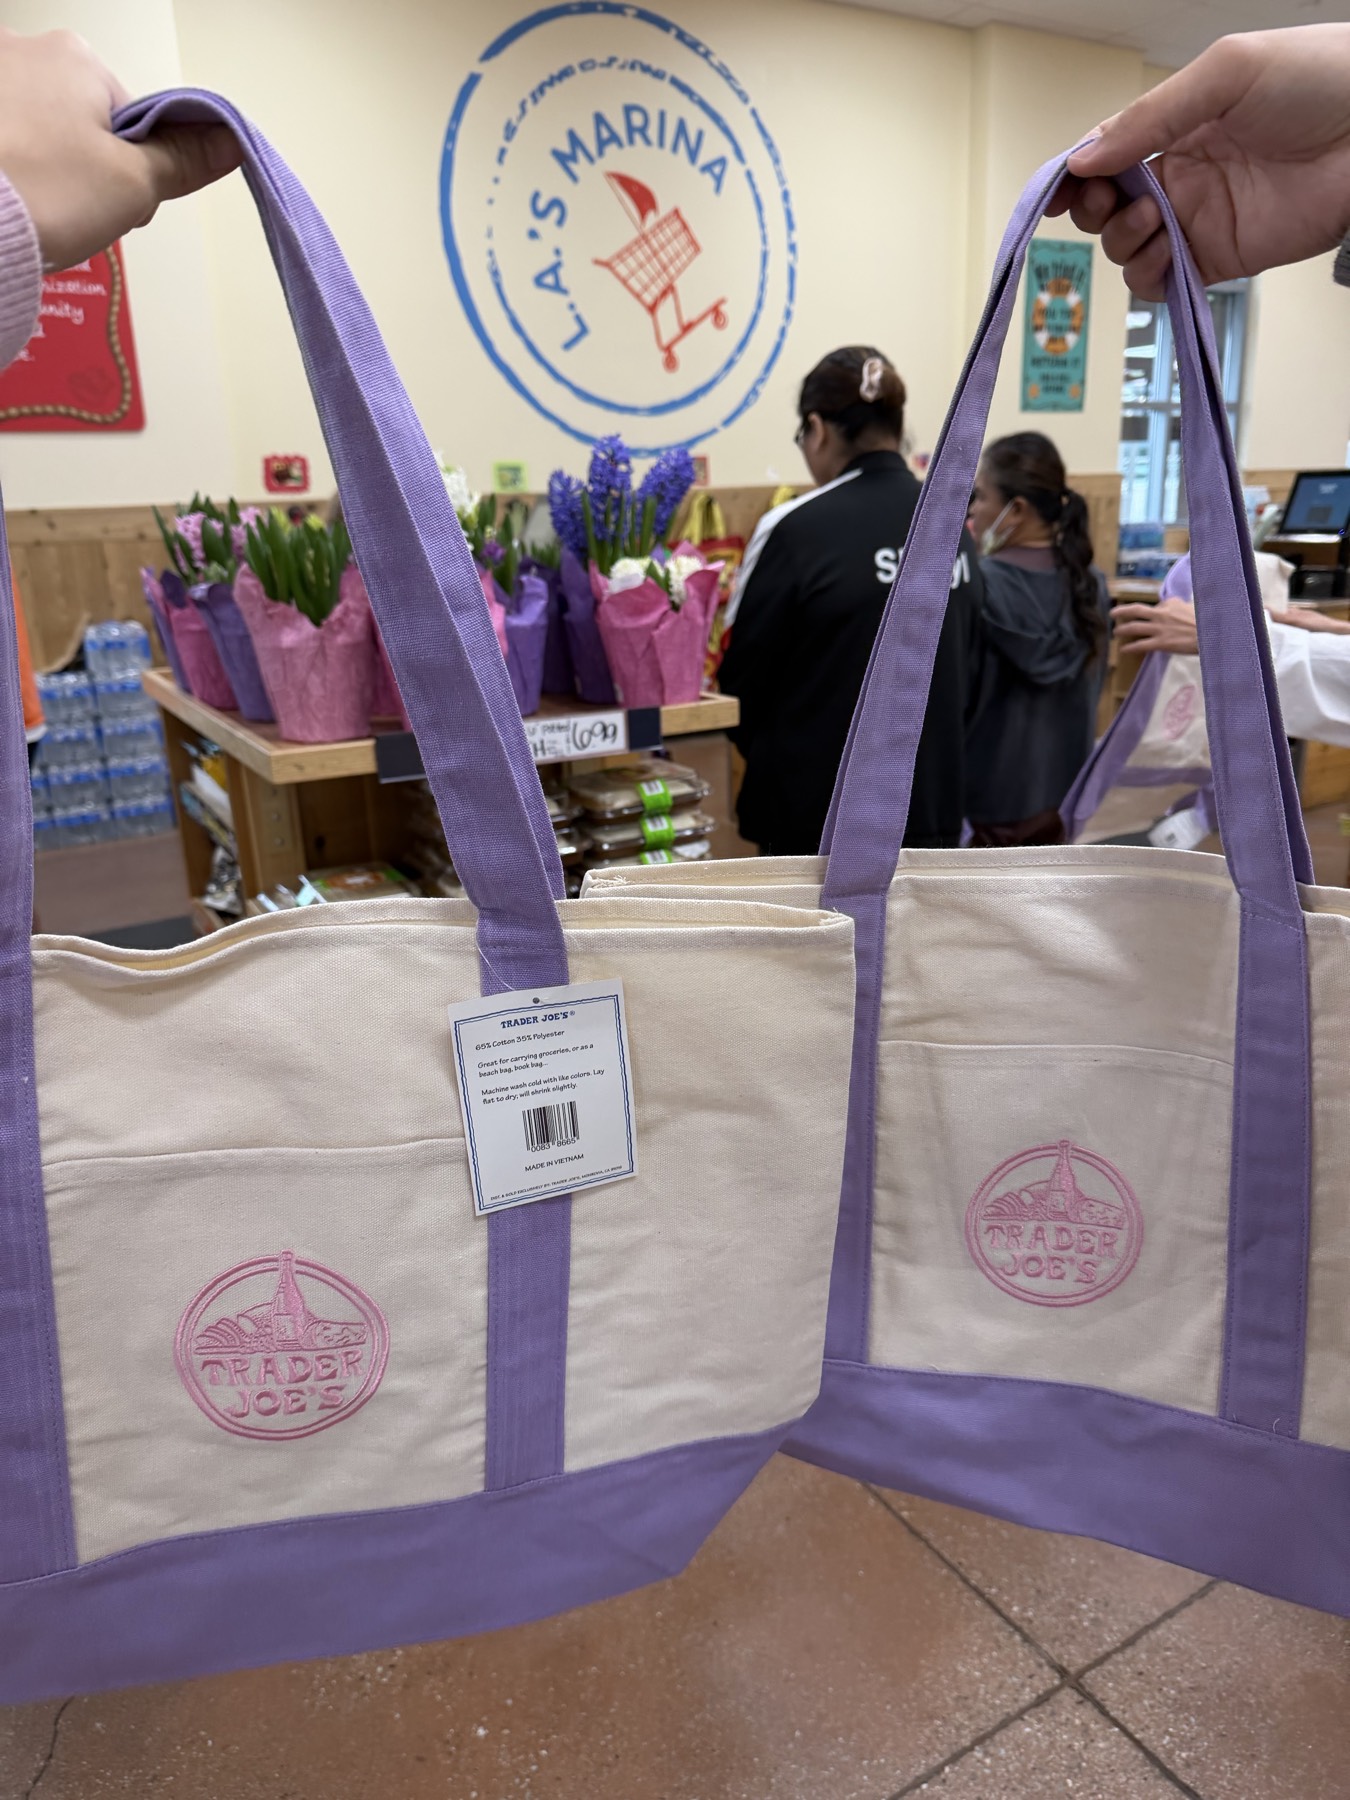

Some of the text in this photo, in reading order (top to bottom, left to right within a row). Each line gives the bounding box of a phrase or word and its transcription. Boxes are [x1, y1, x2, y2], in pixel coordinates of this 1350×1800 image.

[550, 103, 728, 195] MARINA
[500, 1016, 539, 1029] TRADER
[475, 1031, 565, 1051] 65% Cotton 35% Polyester
[477, 1060, 498, 1069] Great
[510, 1052, 537, 1063] carrying
[538, 1047, 571, 1058] groceries,
[478, 1069, 499, 1078] beach
[499, 1066, 513, 1074] bag,
[514, 1063, 530, 1071] book
[481, 1085, 509, 1096] Machine
[510, 1082, 527, 1091] wash
[528, 1079, 542, 1087] cold
[543, 1076, 558, 1084] with
[570, 1071, 592, 1080] colors.
[593, 1068, 605, 1076] Lay
[519, 1089, 530, 1097] will
[531, 1087, 551, 1096] shrink
[552, 1082, 578, 1092] slightly.
[531, 1138, 576, 1152] 0083 8665
[524, 1162, 545, 1172] MADE
[554, 1153, 584, 1165] VIETNAM
[984, 1223, 1118, 1259] TRADER
[1001, 1252, 1100, 1284] JOE'S
[200, 1349, 365, 1387] TRADER
[223, 1383, 347, 1418] JOE'S
